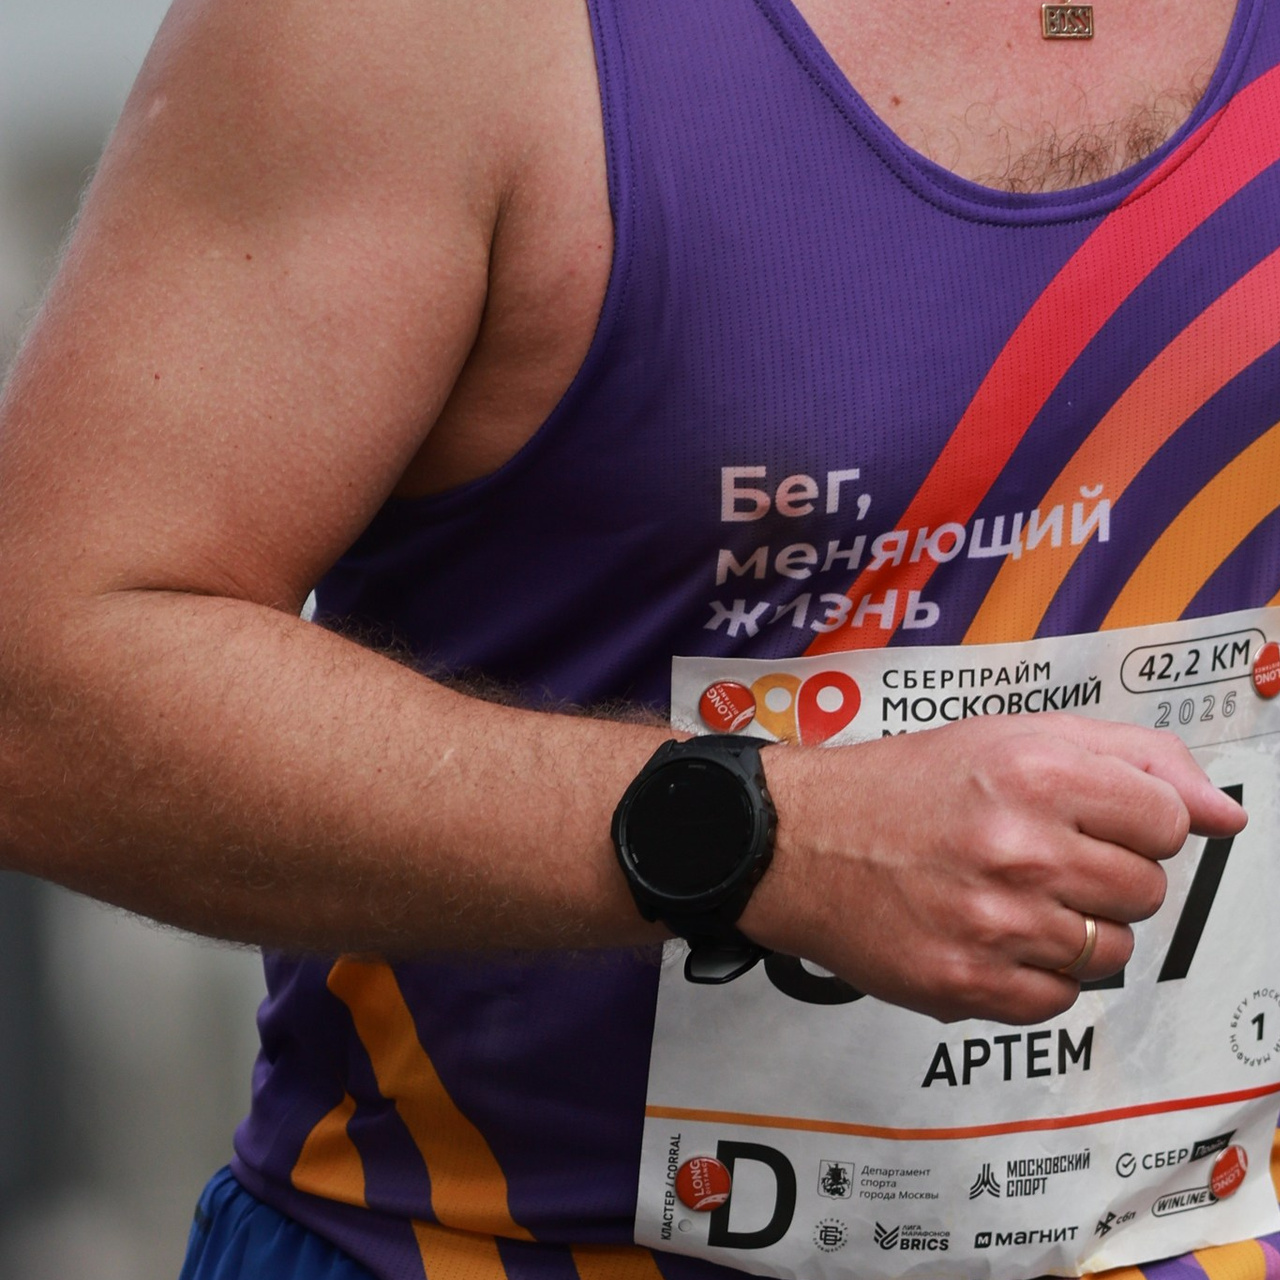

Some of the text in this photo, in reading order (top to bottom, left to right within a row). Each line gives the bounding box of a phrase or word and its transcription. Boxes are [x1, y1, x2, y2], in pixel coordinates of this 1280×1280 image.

[721, 465, 872, 522] Бег,
[715, 483, 1110, 586] меняющий
[703, 589, 940, 638] жизнь
[882, 660, 1051, 689] СБЕРПРАЙМ
[1138, 639, 1251, 682] 42,2 КМ
[1255, 668, 1280, 686] LONG
[706, 687, 734, 721] LONG
[882, 676, 1102, 723] МОСКОВСКИЙ
[1154, 690, 1237, 729] 2026
[1251, 1012, 1265, 1041] 1
[921, 1026, 1095, 1088] АРТЕМ
[666, 1132, 682, 1181] CORRAL
[861, 1165, 931, 1178] Департамент
[1006, 1148, 1091, 1178] МОСКОВСКИЙ
[1142, 1148, 1189, 1170] СБЕР
[690, 1160, 705, 1197] LONG
[702, 1161, 712, 1196] DISTANC
[707, 1139, 797, 1250] D
[859, 1190, 939, 1200] города Москвы
[860, 1178, 897, 1189] спорта
[1006, 1177, 1048, 1198] СПОРТ
[661, 1190, 677, 1241] КЛАСТЕР
[1156, 1190, 1208, 1212] WINLINE
[900, 1238, 950, 1251] BRICS
